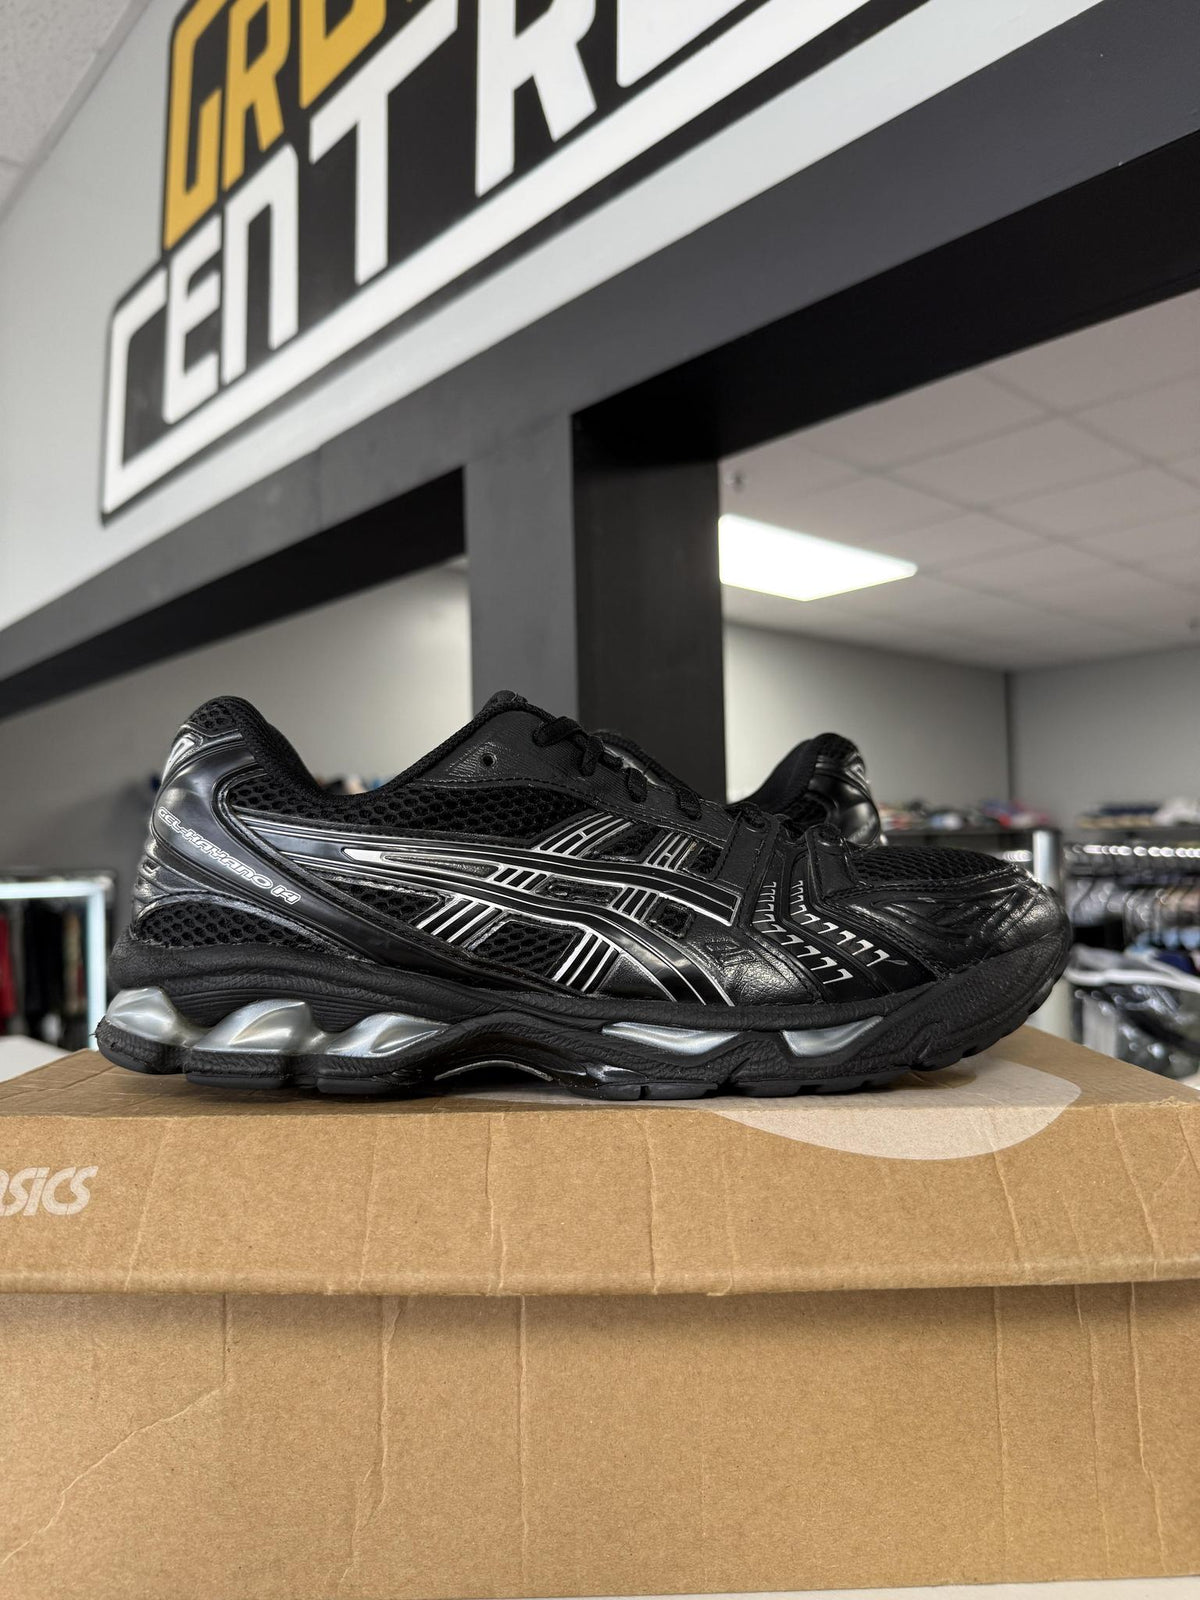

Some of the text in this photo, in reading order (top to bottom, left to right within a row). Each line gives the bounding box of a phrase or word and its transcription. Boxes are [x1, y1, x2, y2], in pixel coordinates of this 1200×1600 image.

[102, 0, 770, 514] CENTR
[157, 806, 302, 905] GEL-KAYANO 14
[0, 1165, 99, 1217] sics
